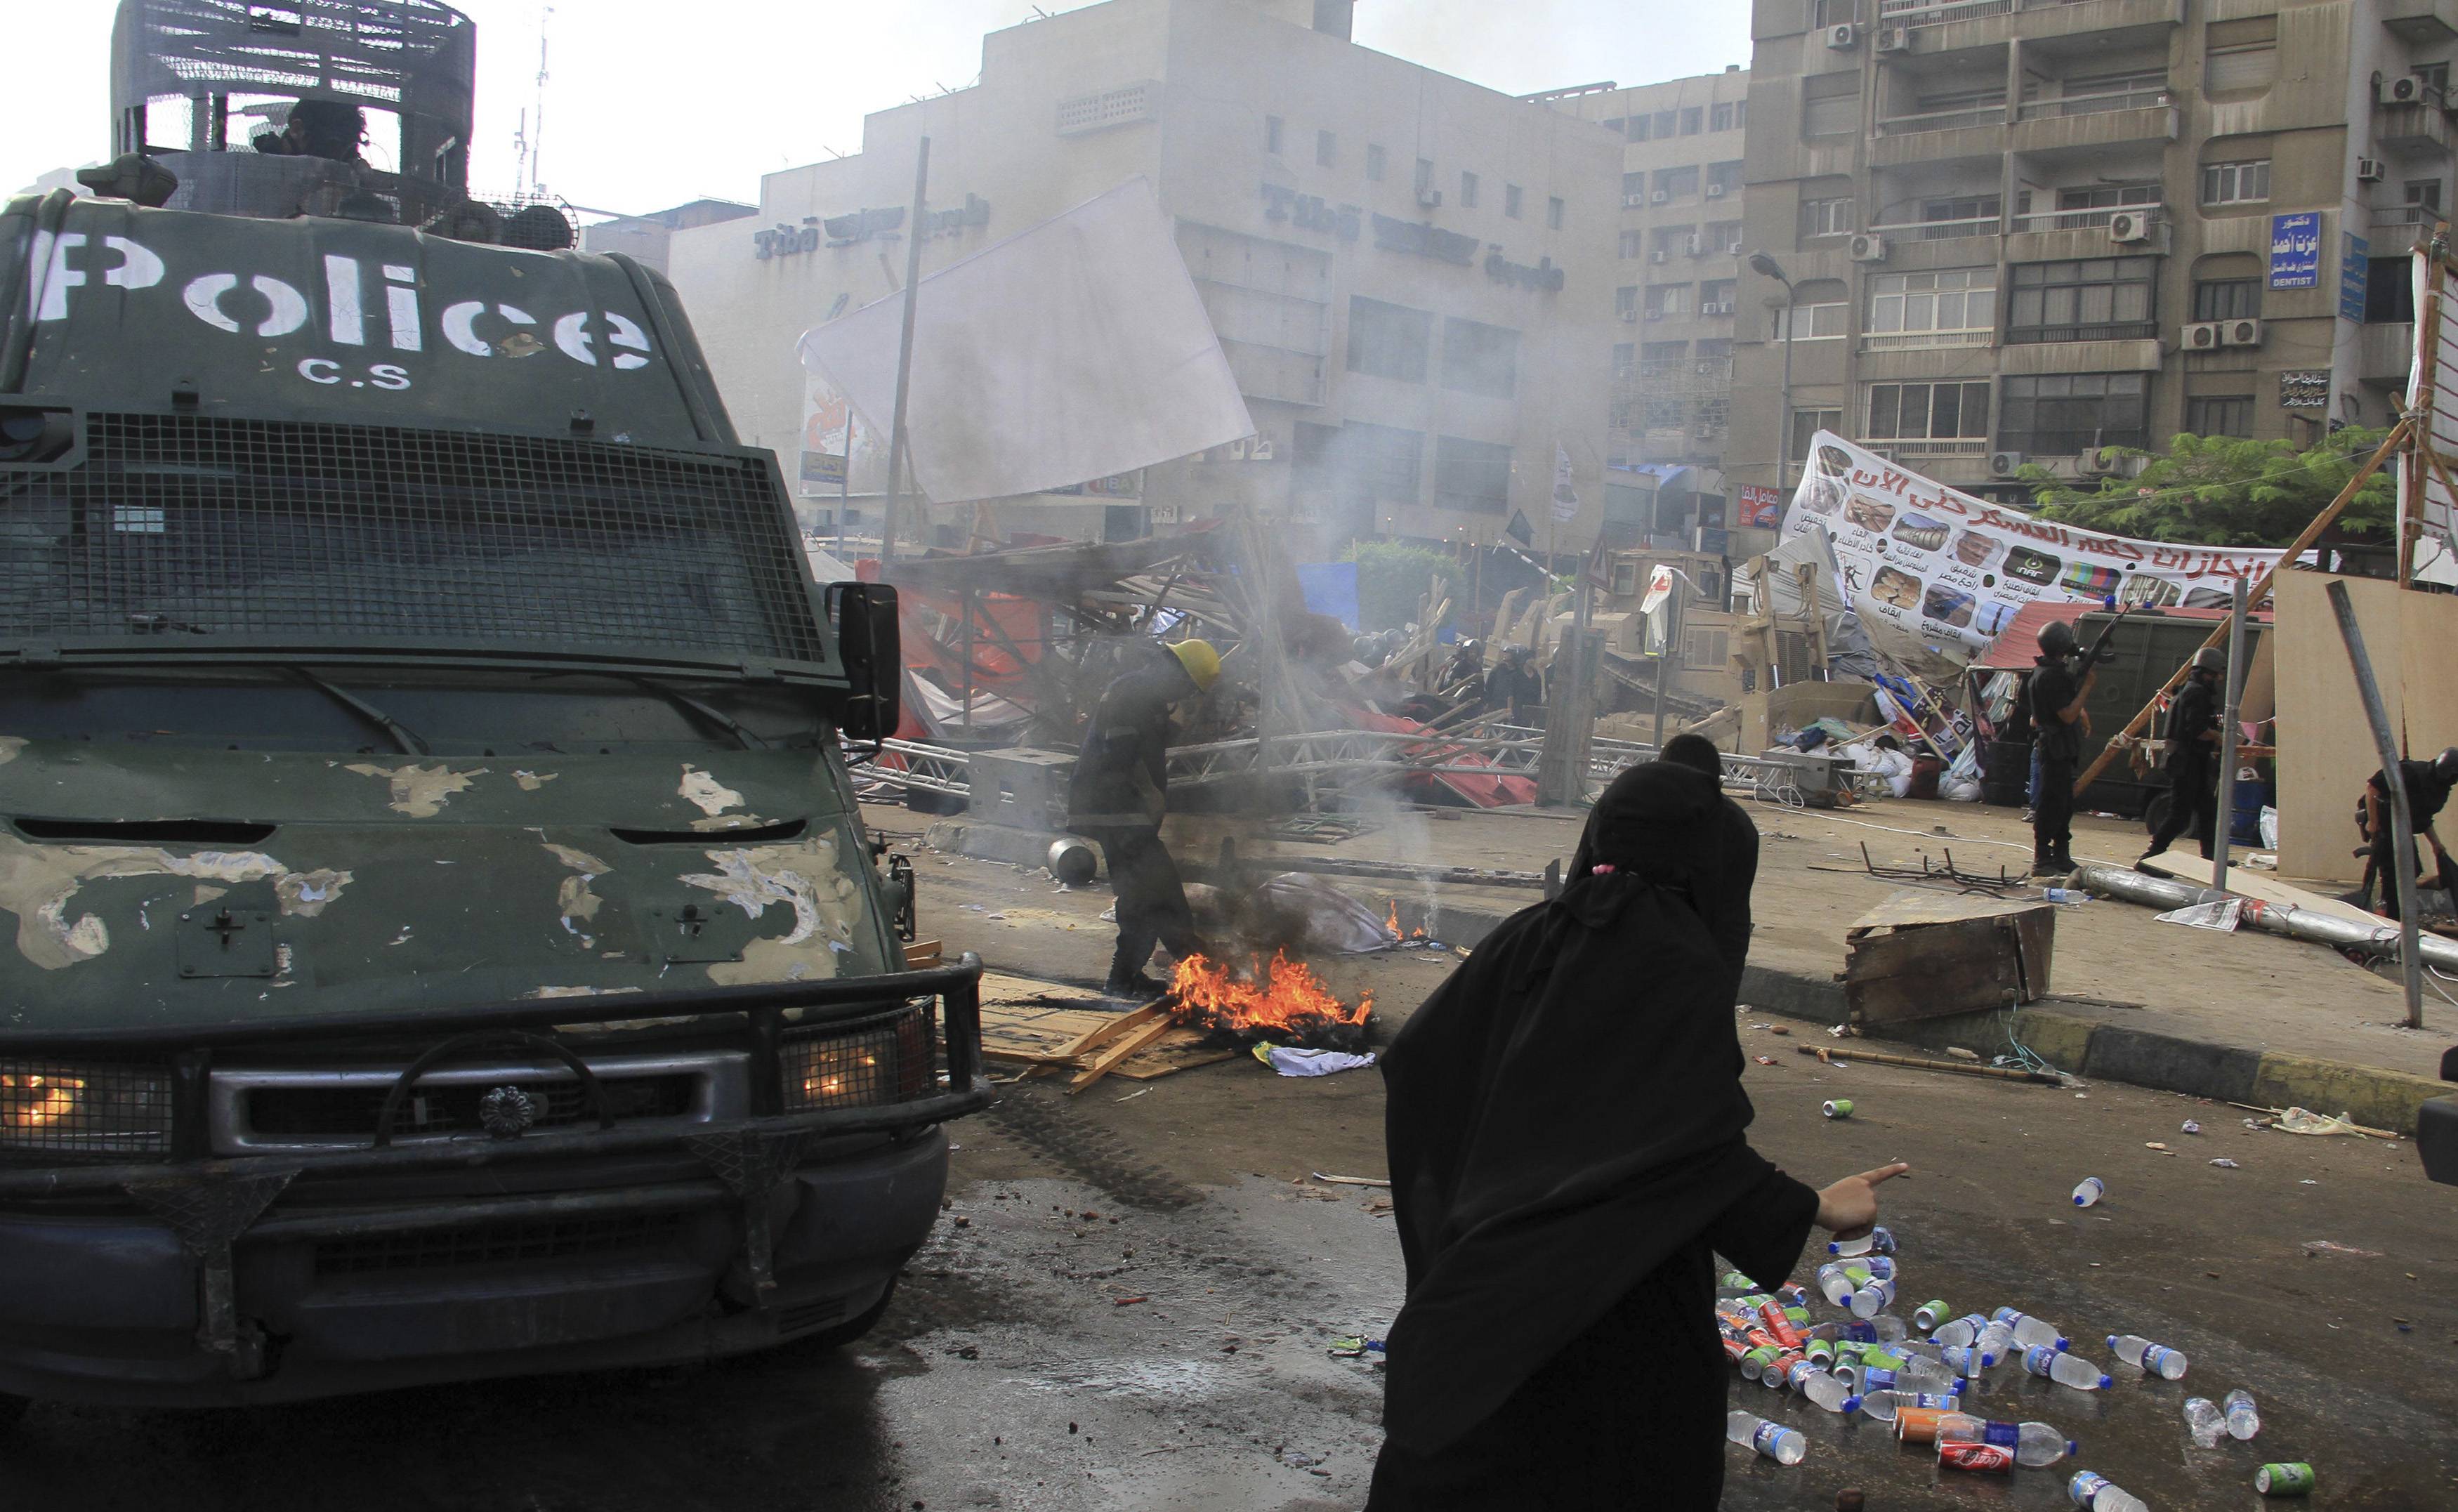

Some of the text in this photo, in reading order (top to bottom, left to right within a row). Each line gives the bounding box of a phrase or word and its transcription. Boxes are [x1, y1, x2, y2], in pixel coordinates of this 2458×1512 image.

[2281, 215, 2310, 230] دكتور
[2271, 231, 2295, 254] أحمد
[2273, 276, 2313, 287] DENTIST
[29, 230, 652, 371] Police
[297, 358, 412, 390] C.S
[1851, 466, 1911, 497] الآن
[1754, 487, 1779, 506] معامل
[1967, 508, 2070, 547] العسكر
[1937, 572, 1958, 584] مصر
[1950, 565, 1978, 579] شفيق
[2066, 595, 2073, 603] 7
[1921, 619, 1943, 635] مشروع
